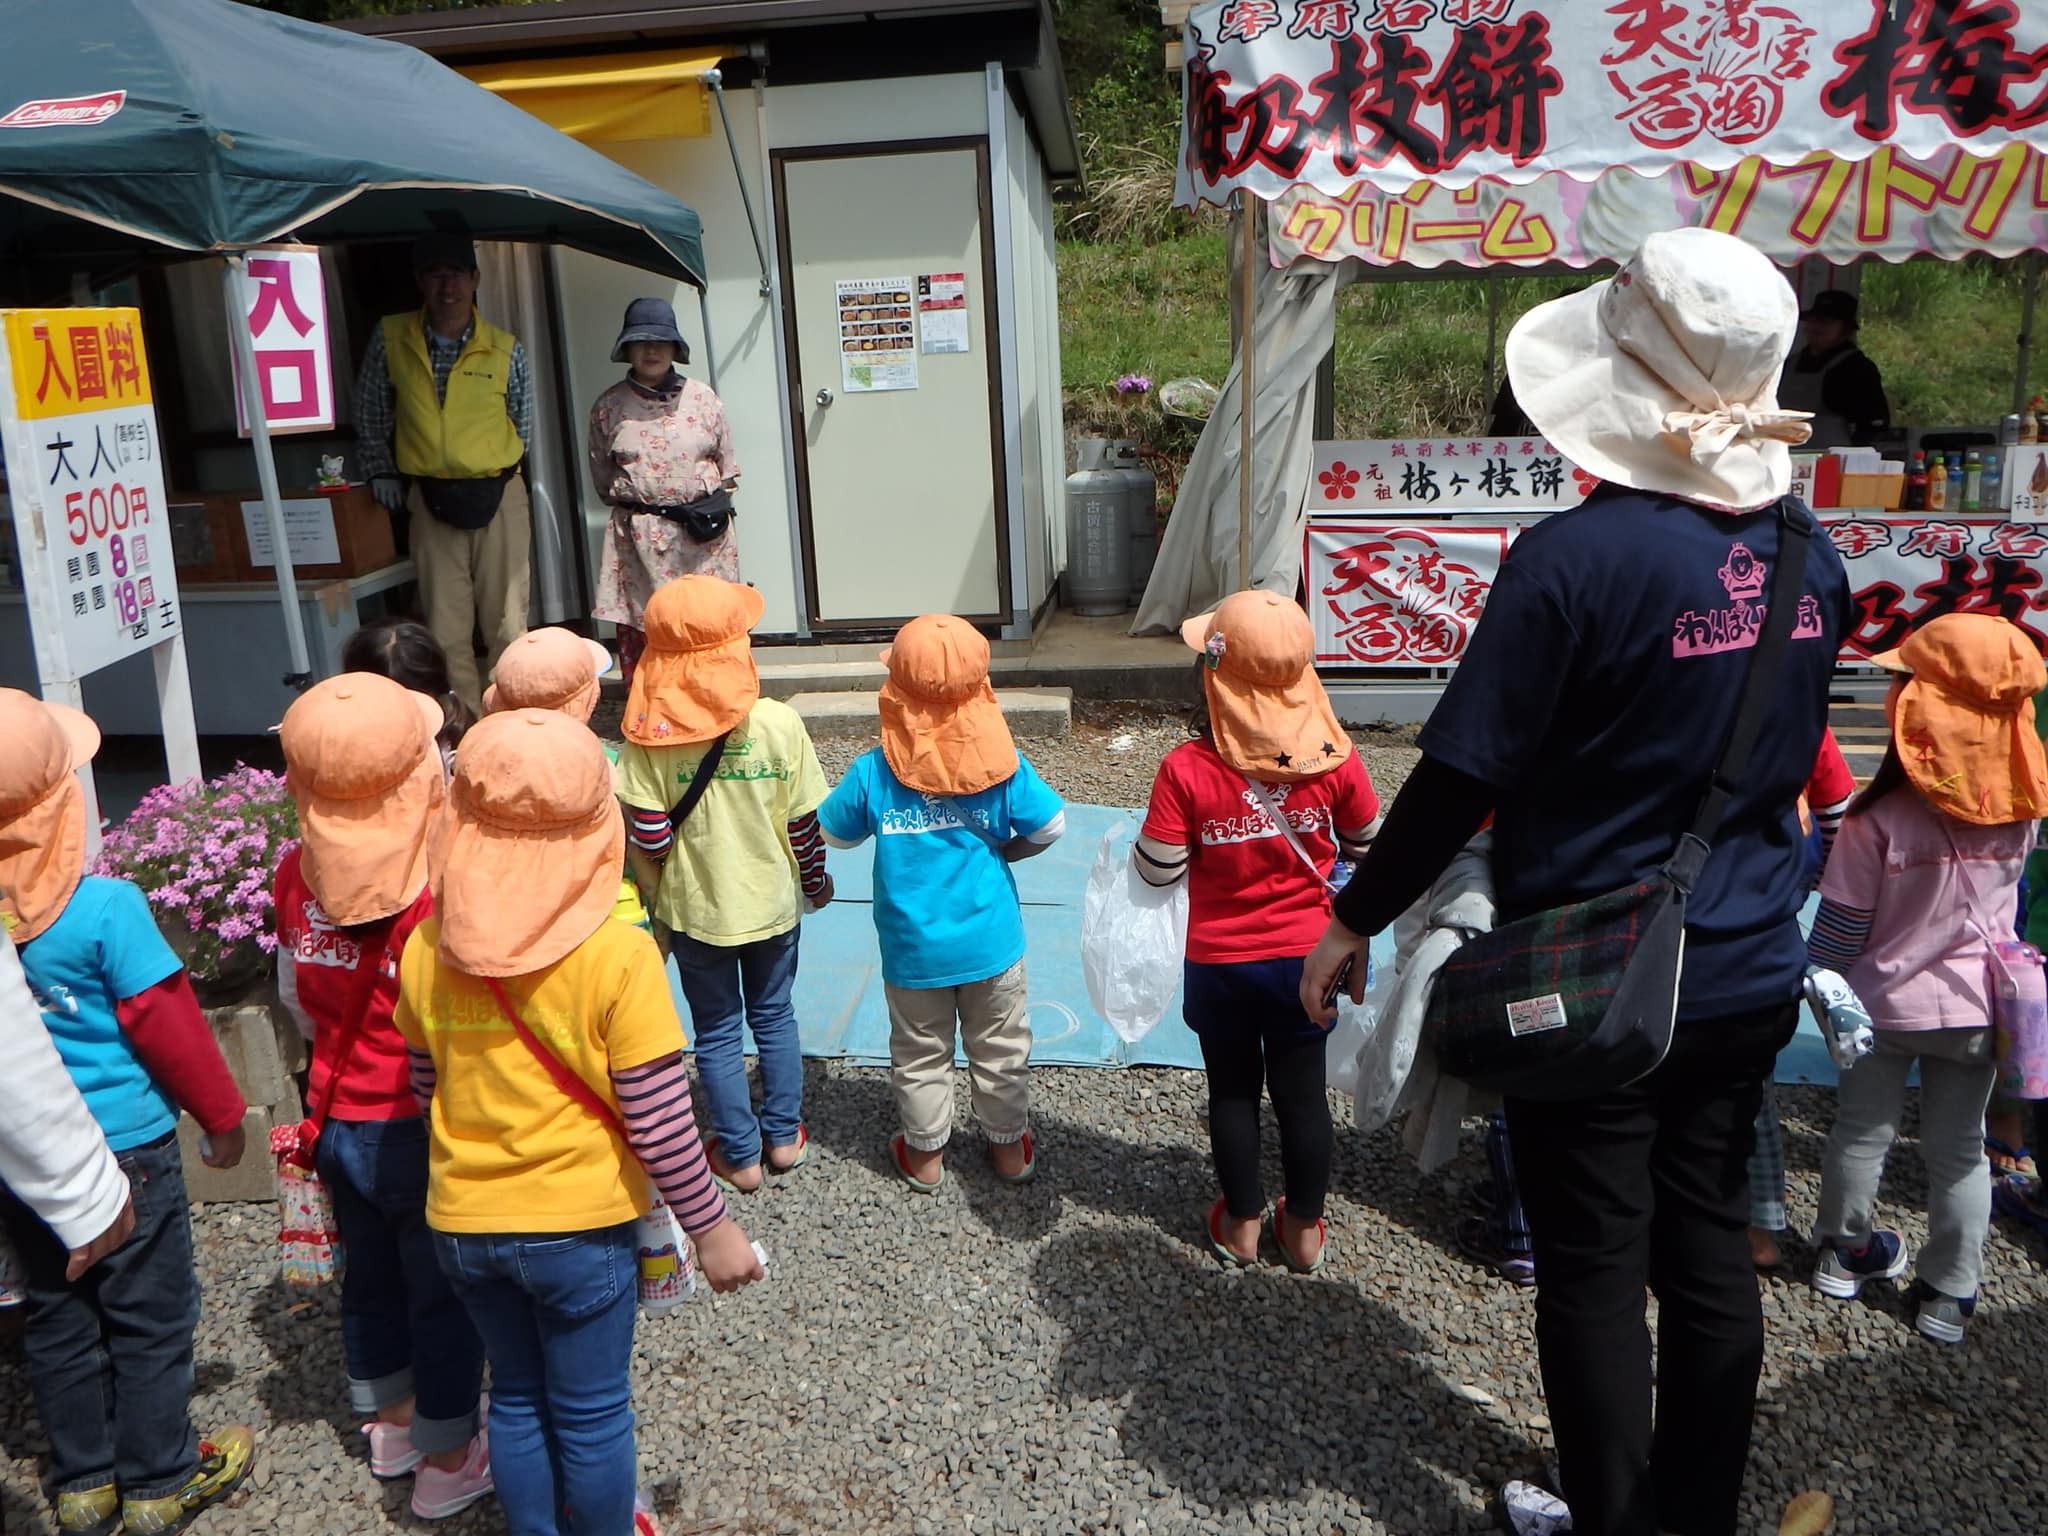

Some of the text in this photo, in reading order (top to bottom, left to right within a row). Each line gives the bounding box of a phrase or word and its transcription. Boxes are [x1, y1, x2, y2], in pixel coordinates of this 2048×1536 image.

[1190, 0, 1511, 46] 宰府名
[1820, 0, 2048, 142] 梅
[13, 104, 98, 121] Coleman
[1281, 200, 1557, 260] クリーム
[33, 321, 141, 405] 入園料
[247, 259, 320, 421] 入口
[46, 424, 117, 486] 大人
[1365, 463, 1393, 501] 元祖
[64, 482, 150, 546] 500円
